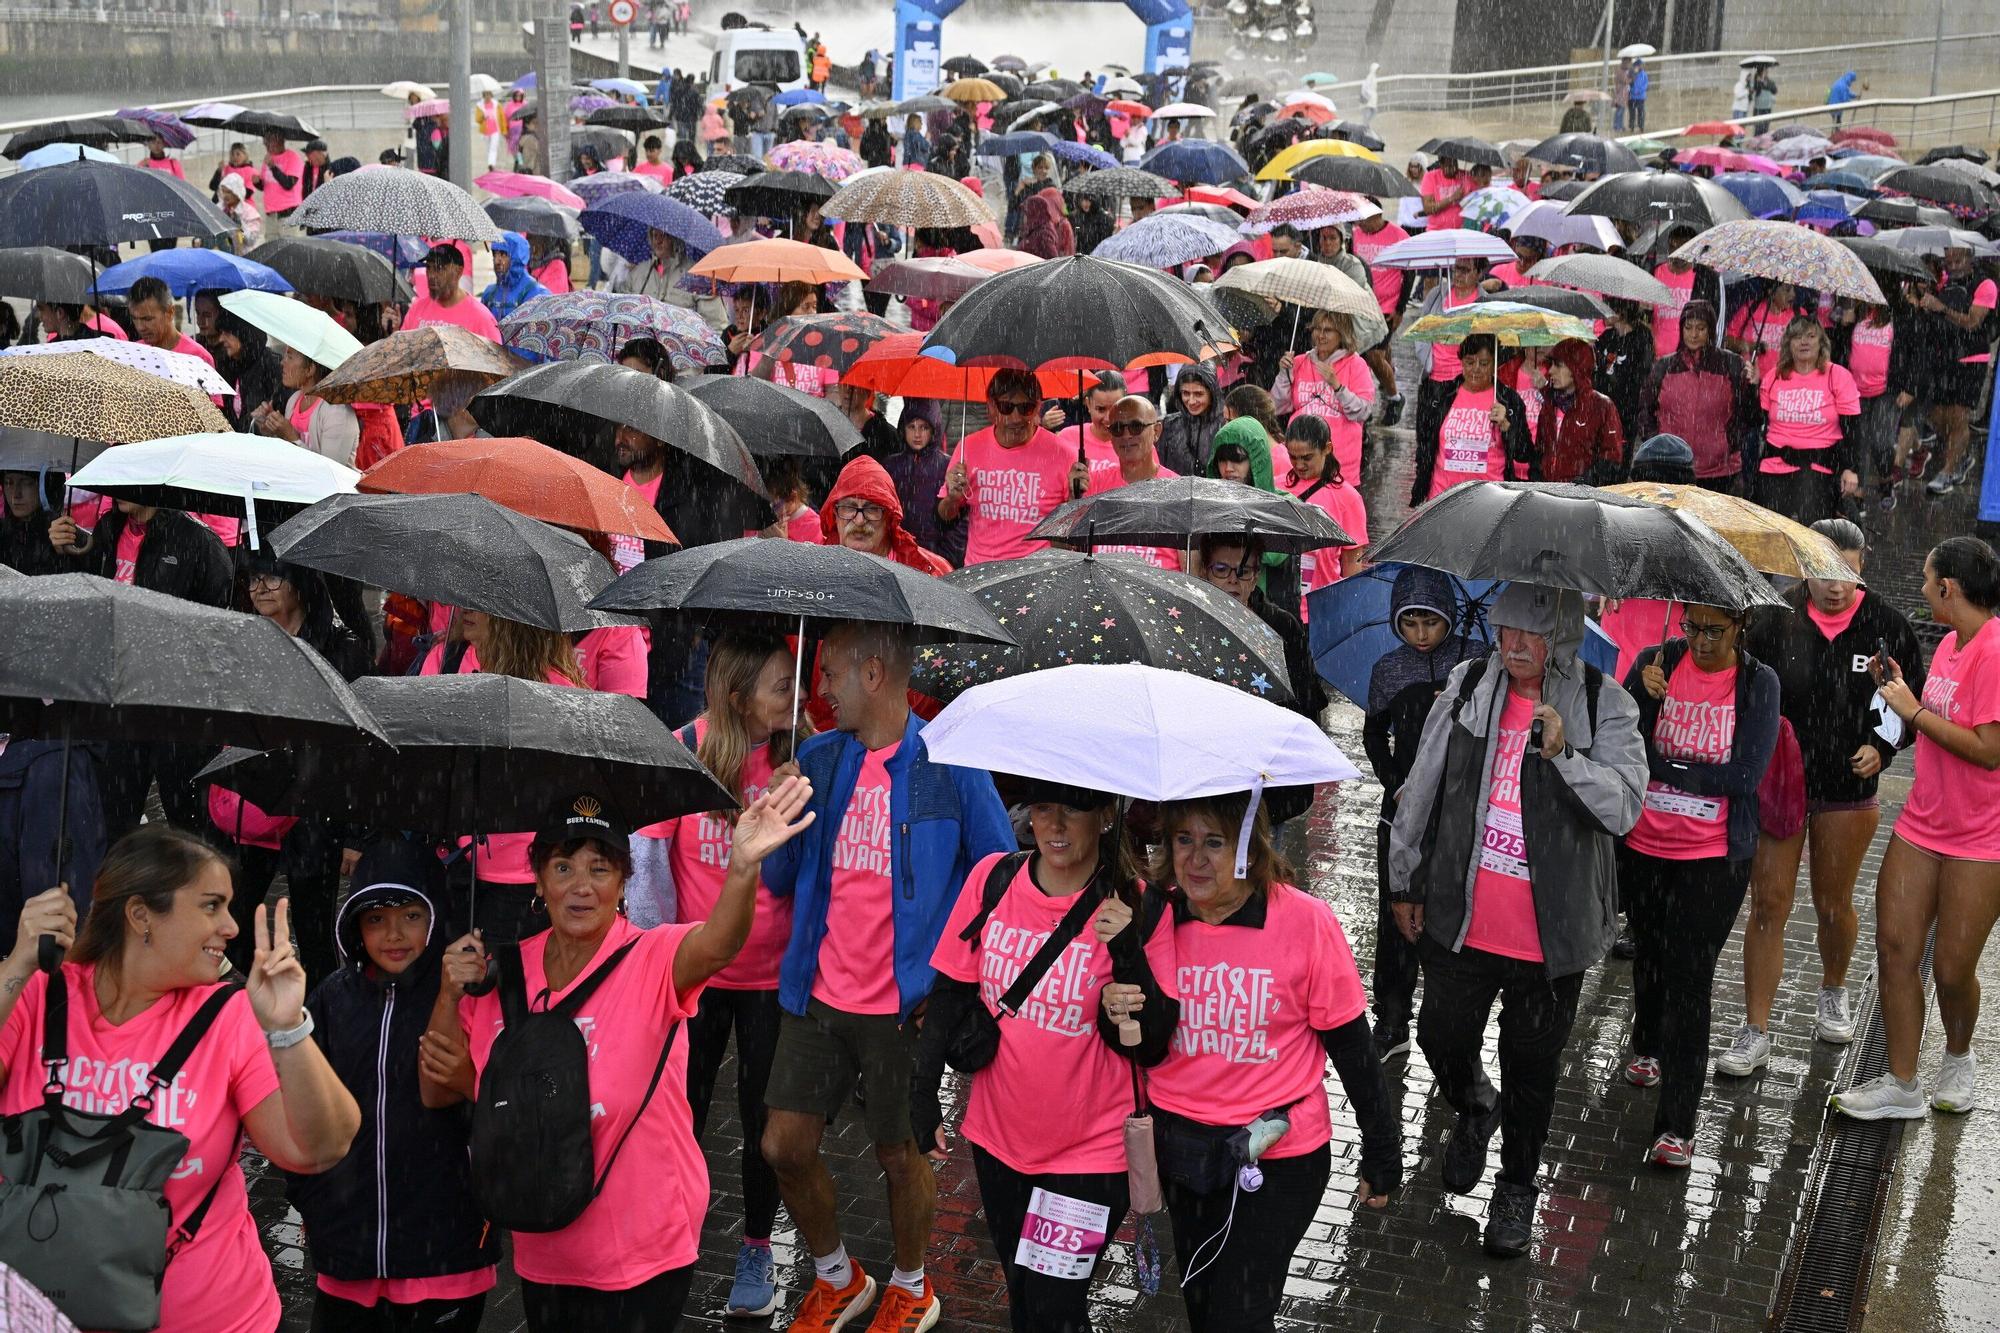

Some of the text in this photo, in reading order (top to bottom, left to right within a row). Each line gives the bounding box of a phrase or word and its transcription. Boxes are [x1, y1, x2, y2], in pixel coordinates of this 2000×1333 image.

[1452, 451, 1479, 460] 2025
[566, 816, 610, 828] BUEN CAMINO
[1033, 1218, 1084, 1252] 2025
